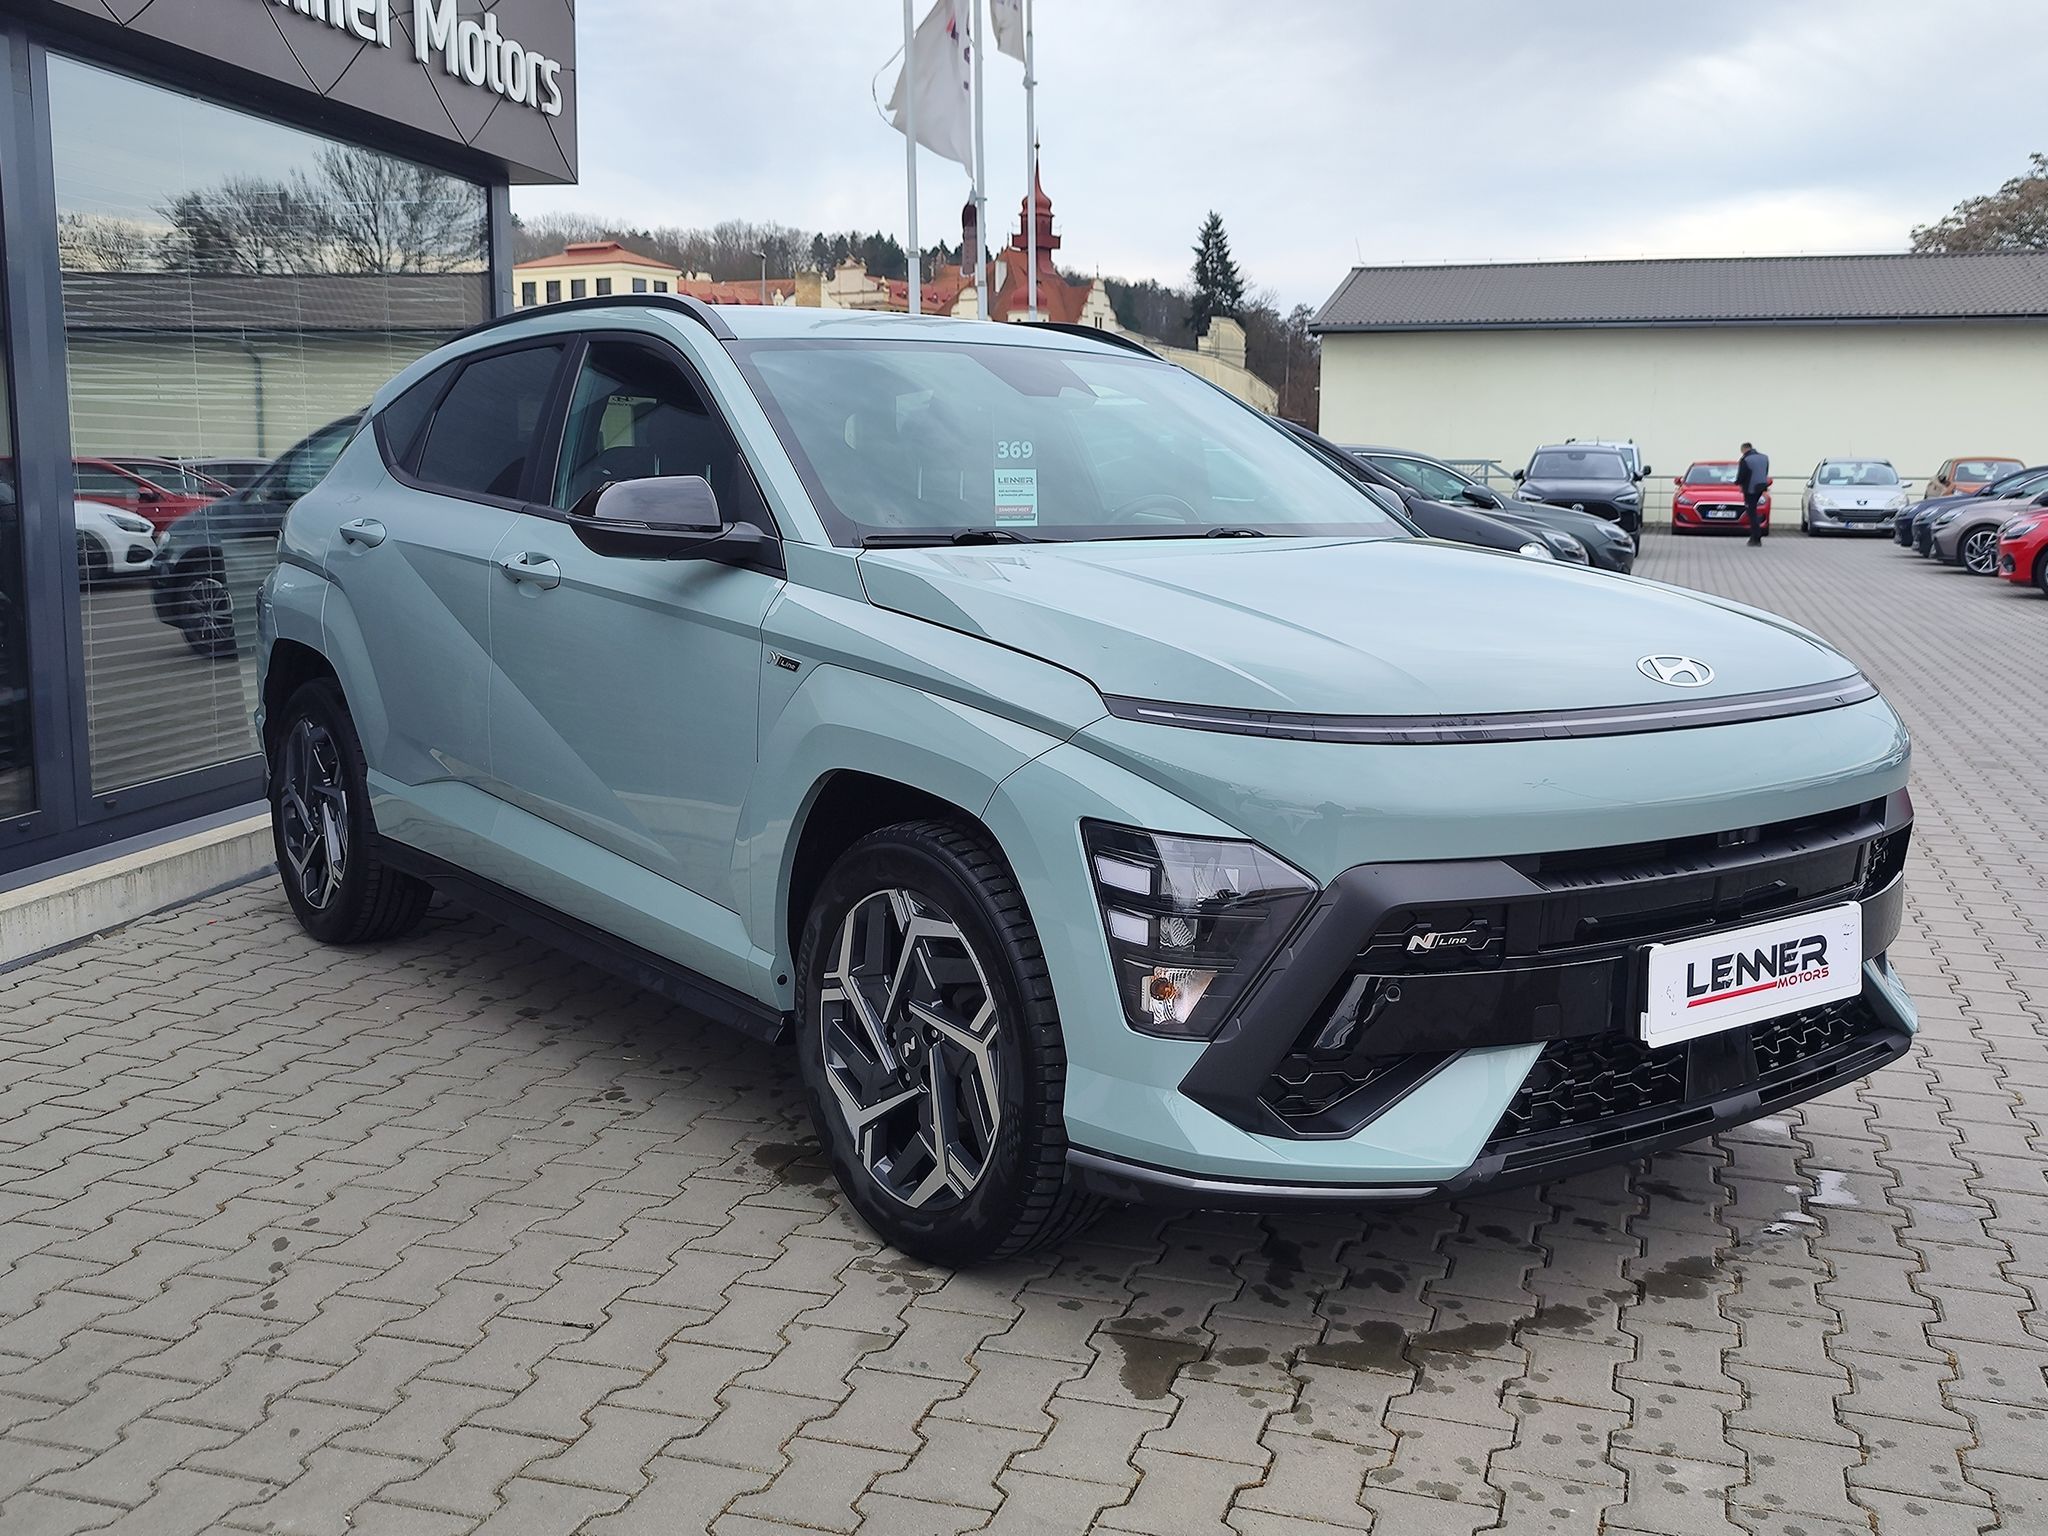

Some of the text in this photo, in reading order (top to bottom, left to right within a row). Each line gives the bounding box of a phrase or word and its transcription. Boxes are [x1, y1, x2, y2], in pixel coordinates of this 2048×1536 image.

[413, 0, 563, 117] Motors
[997, 441, 1033, 458] 369
[998, 477, 1034, 485] LENNER
[1686, 934, 1829, 998] LENNER
[1777, 966, 1830, 990] MOTORS
